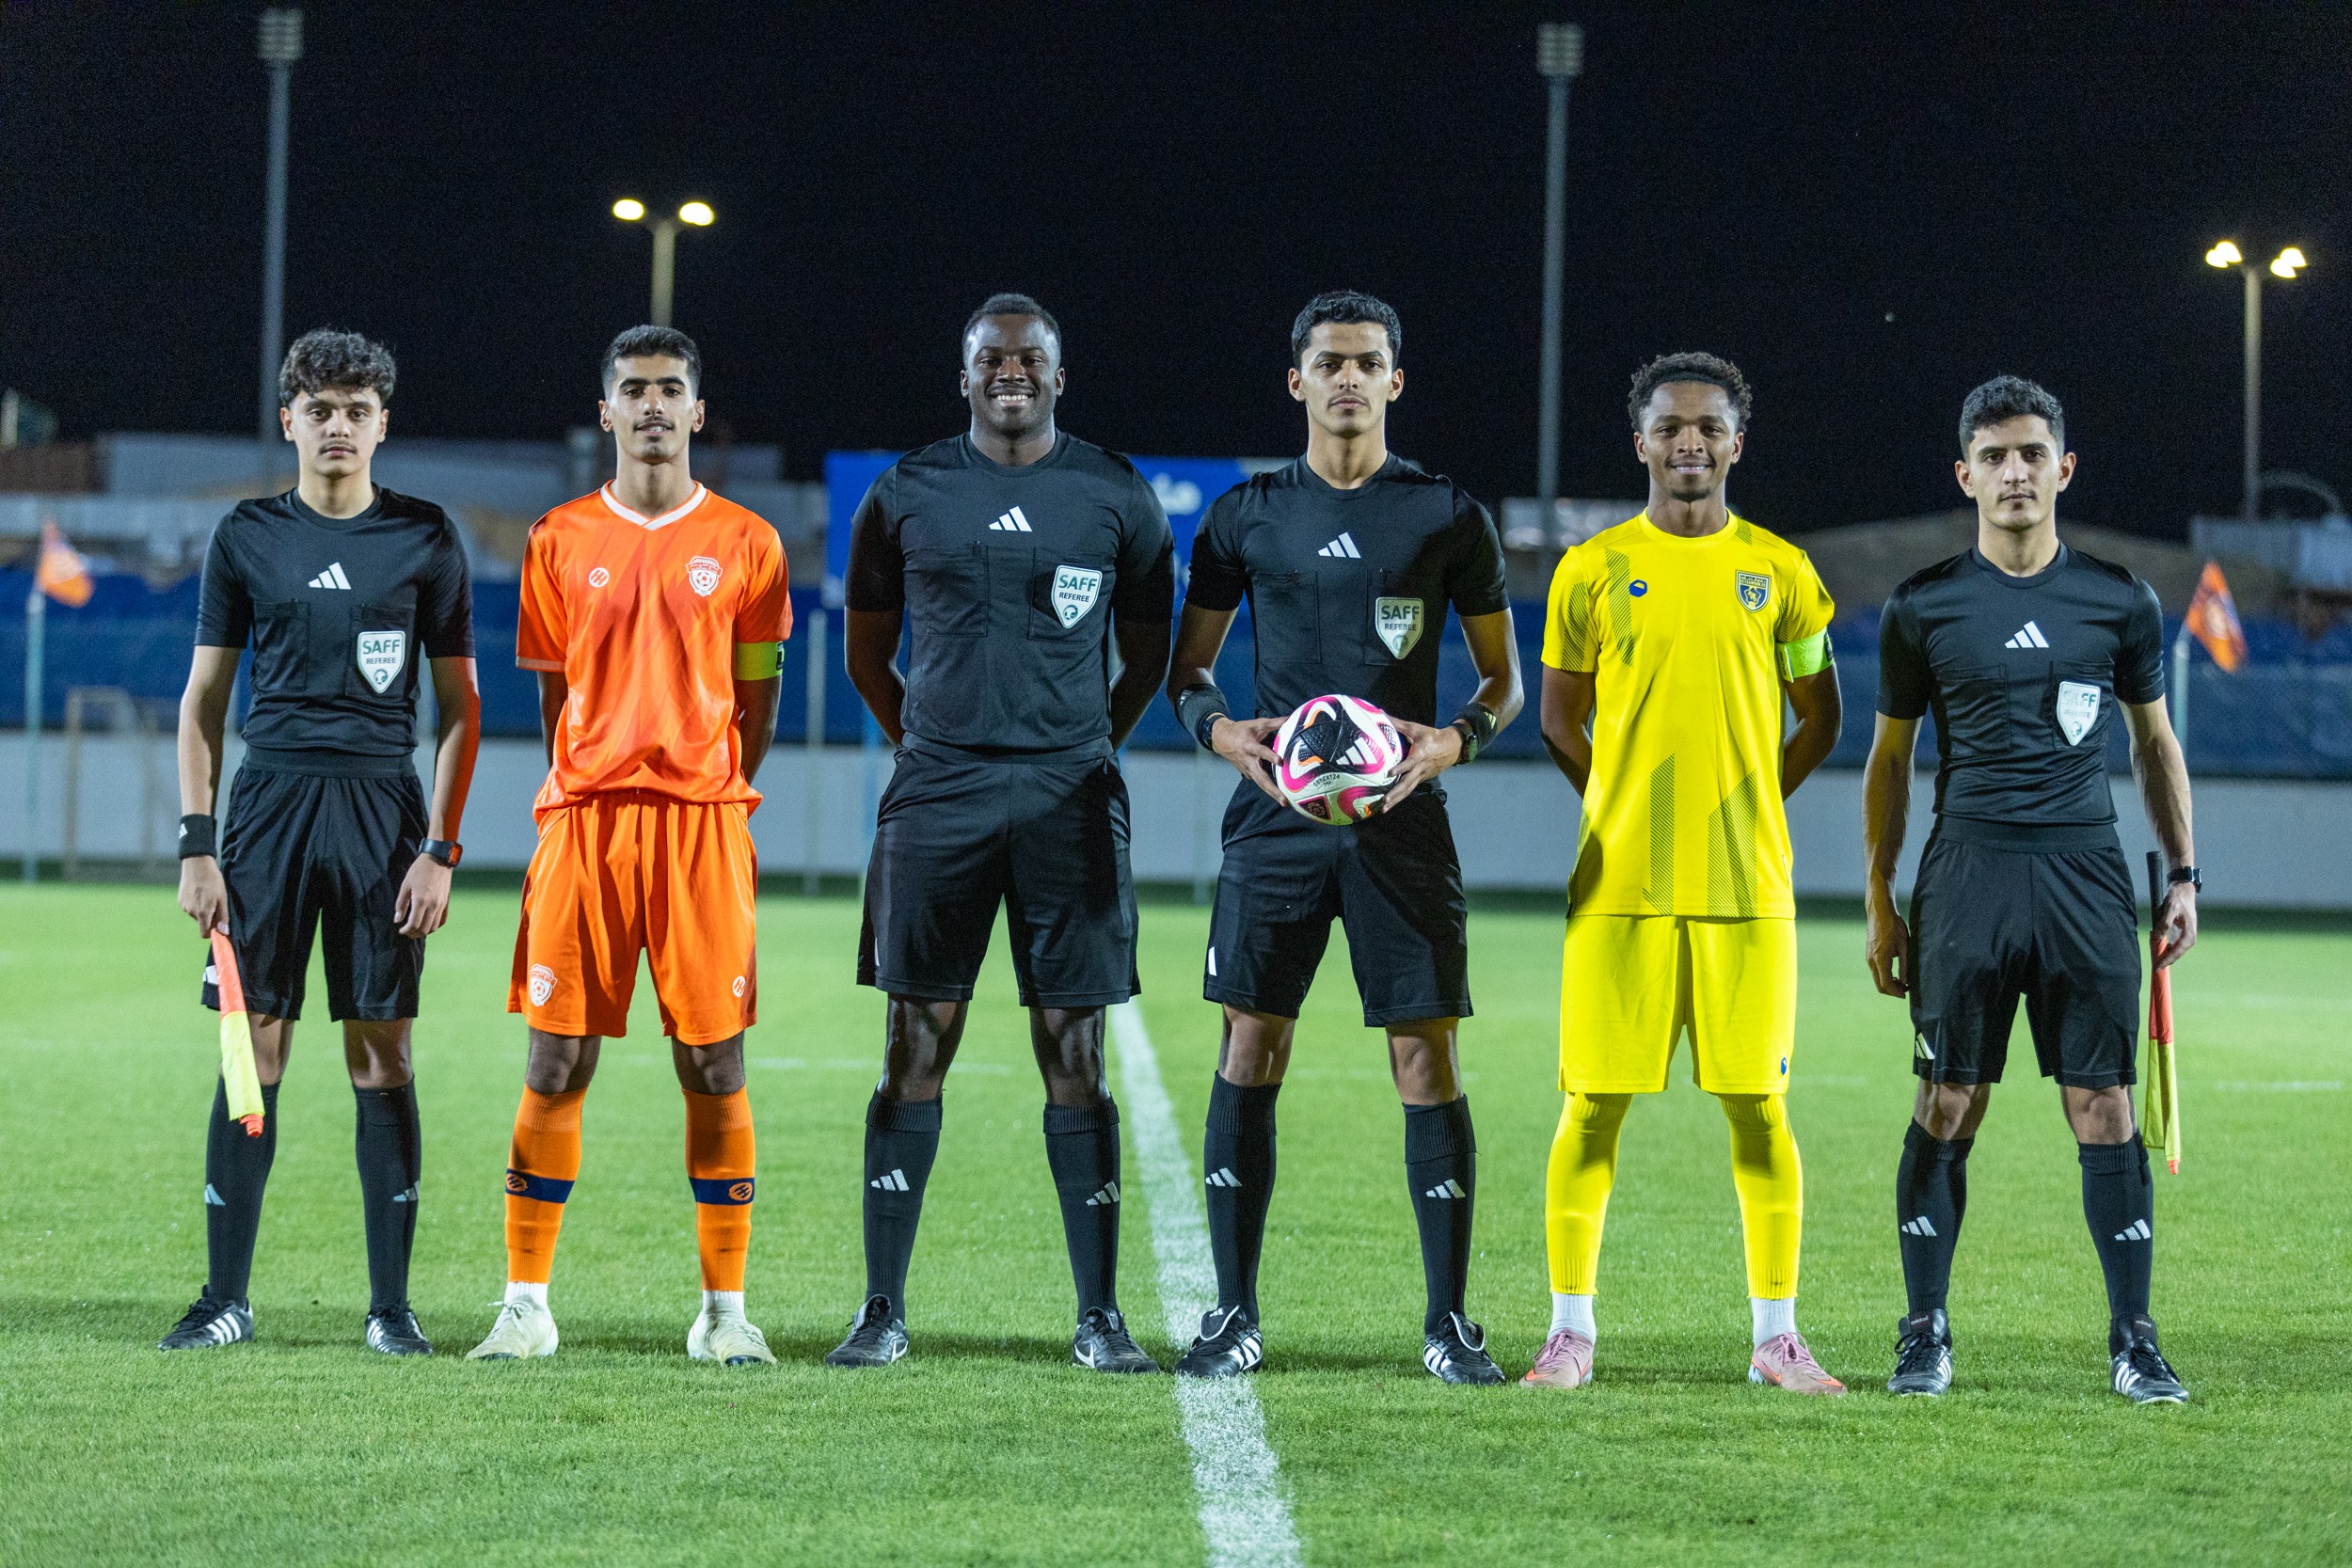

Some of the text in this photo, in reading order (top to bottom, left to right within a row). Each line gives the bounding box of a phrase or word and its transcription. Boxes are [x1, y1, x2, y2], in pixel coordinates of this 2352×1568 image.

[1058, 575, 1097, 592] SAFF
[1059, 592, 1089, 602] REFEREE
[1380, 605, 1420, 620] SAFF
[1384, 623, 1417, 631] REFEREE
[362, 640, 400, 655] SAFF
